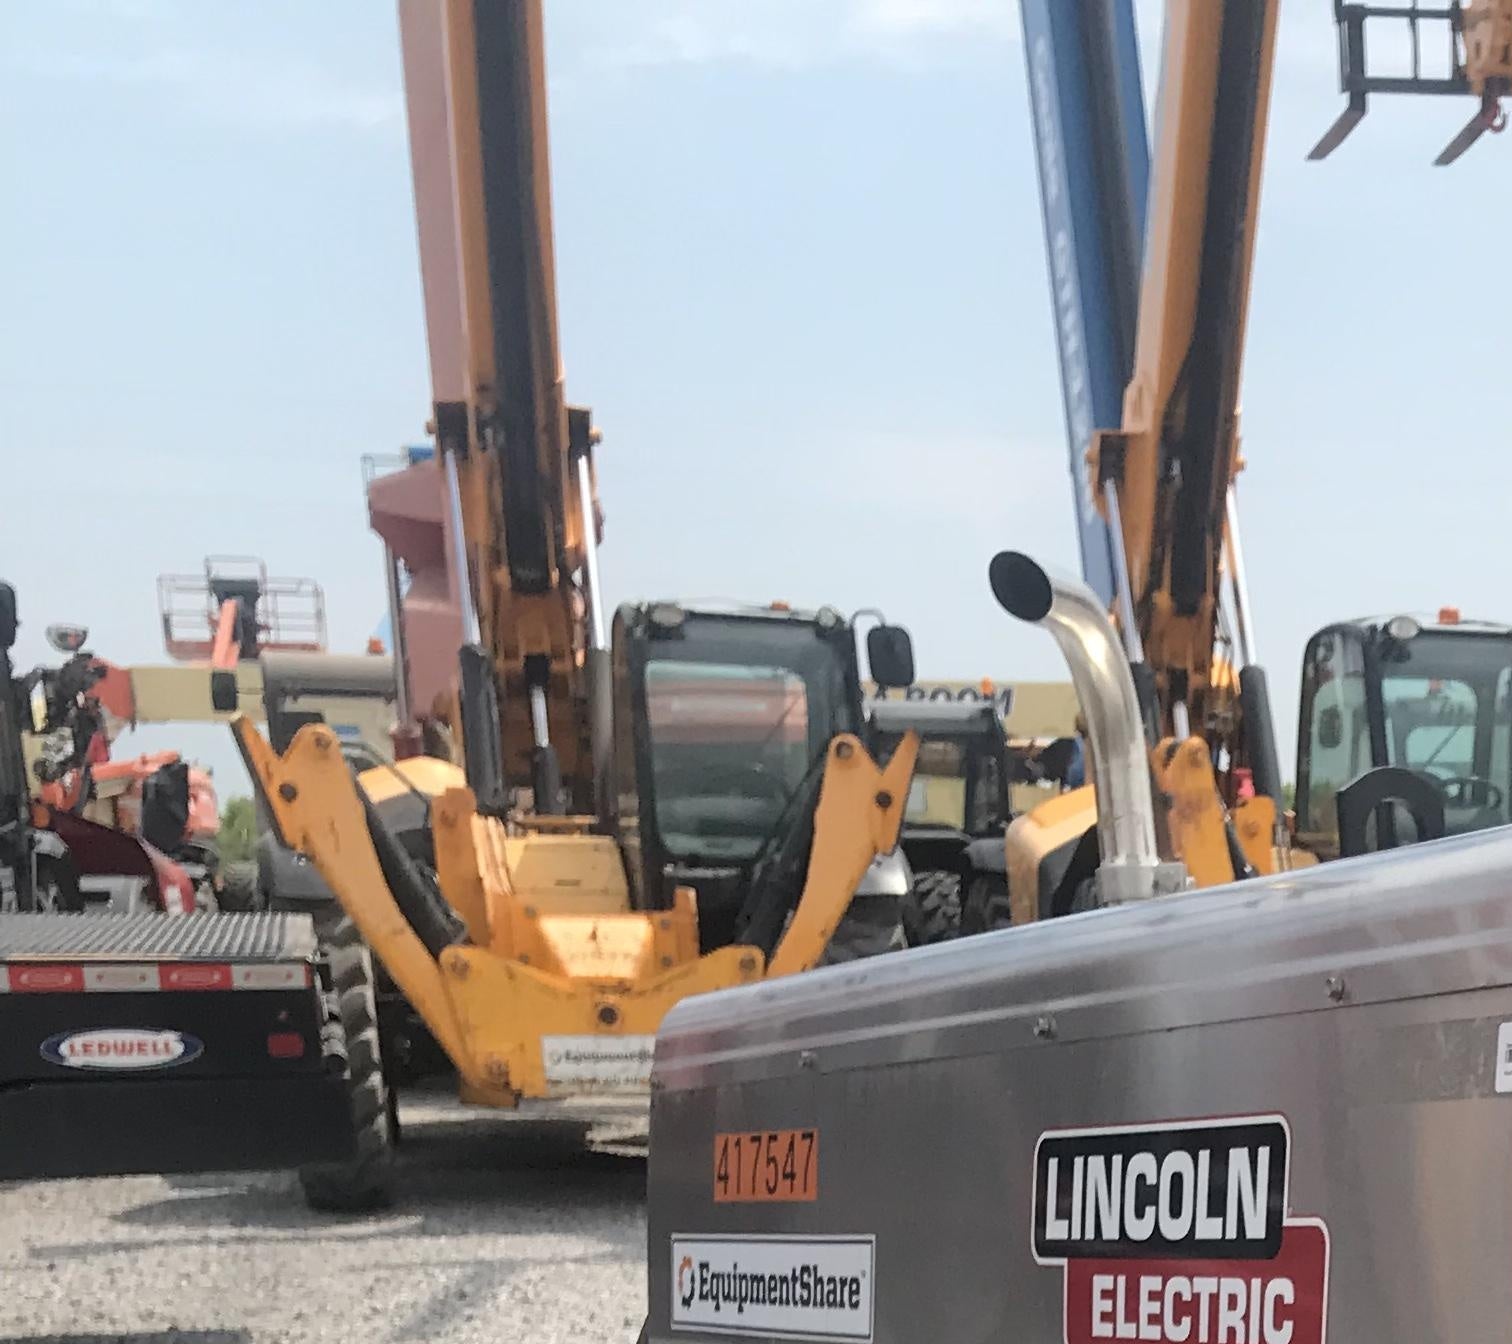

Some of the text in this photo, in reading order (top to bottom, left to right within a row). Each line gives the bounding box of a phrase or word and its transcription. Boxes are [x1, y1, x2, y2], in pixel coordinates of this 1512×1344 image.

[717, 1132, 814, 1195] 417547
[1045, 1146, 1271, 1242] LINCOLN
[699, 1261, 861, 1314] EquipmentShare
